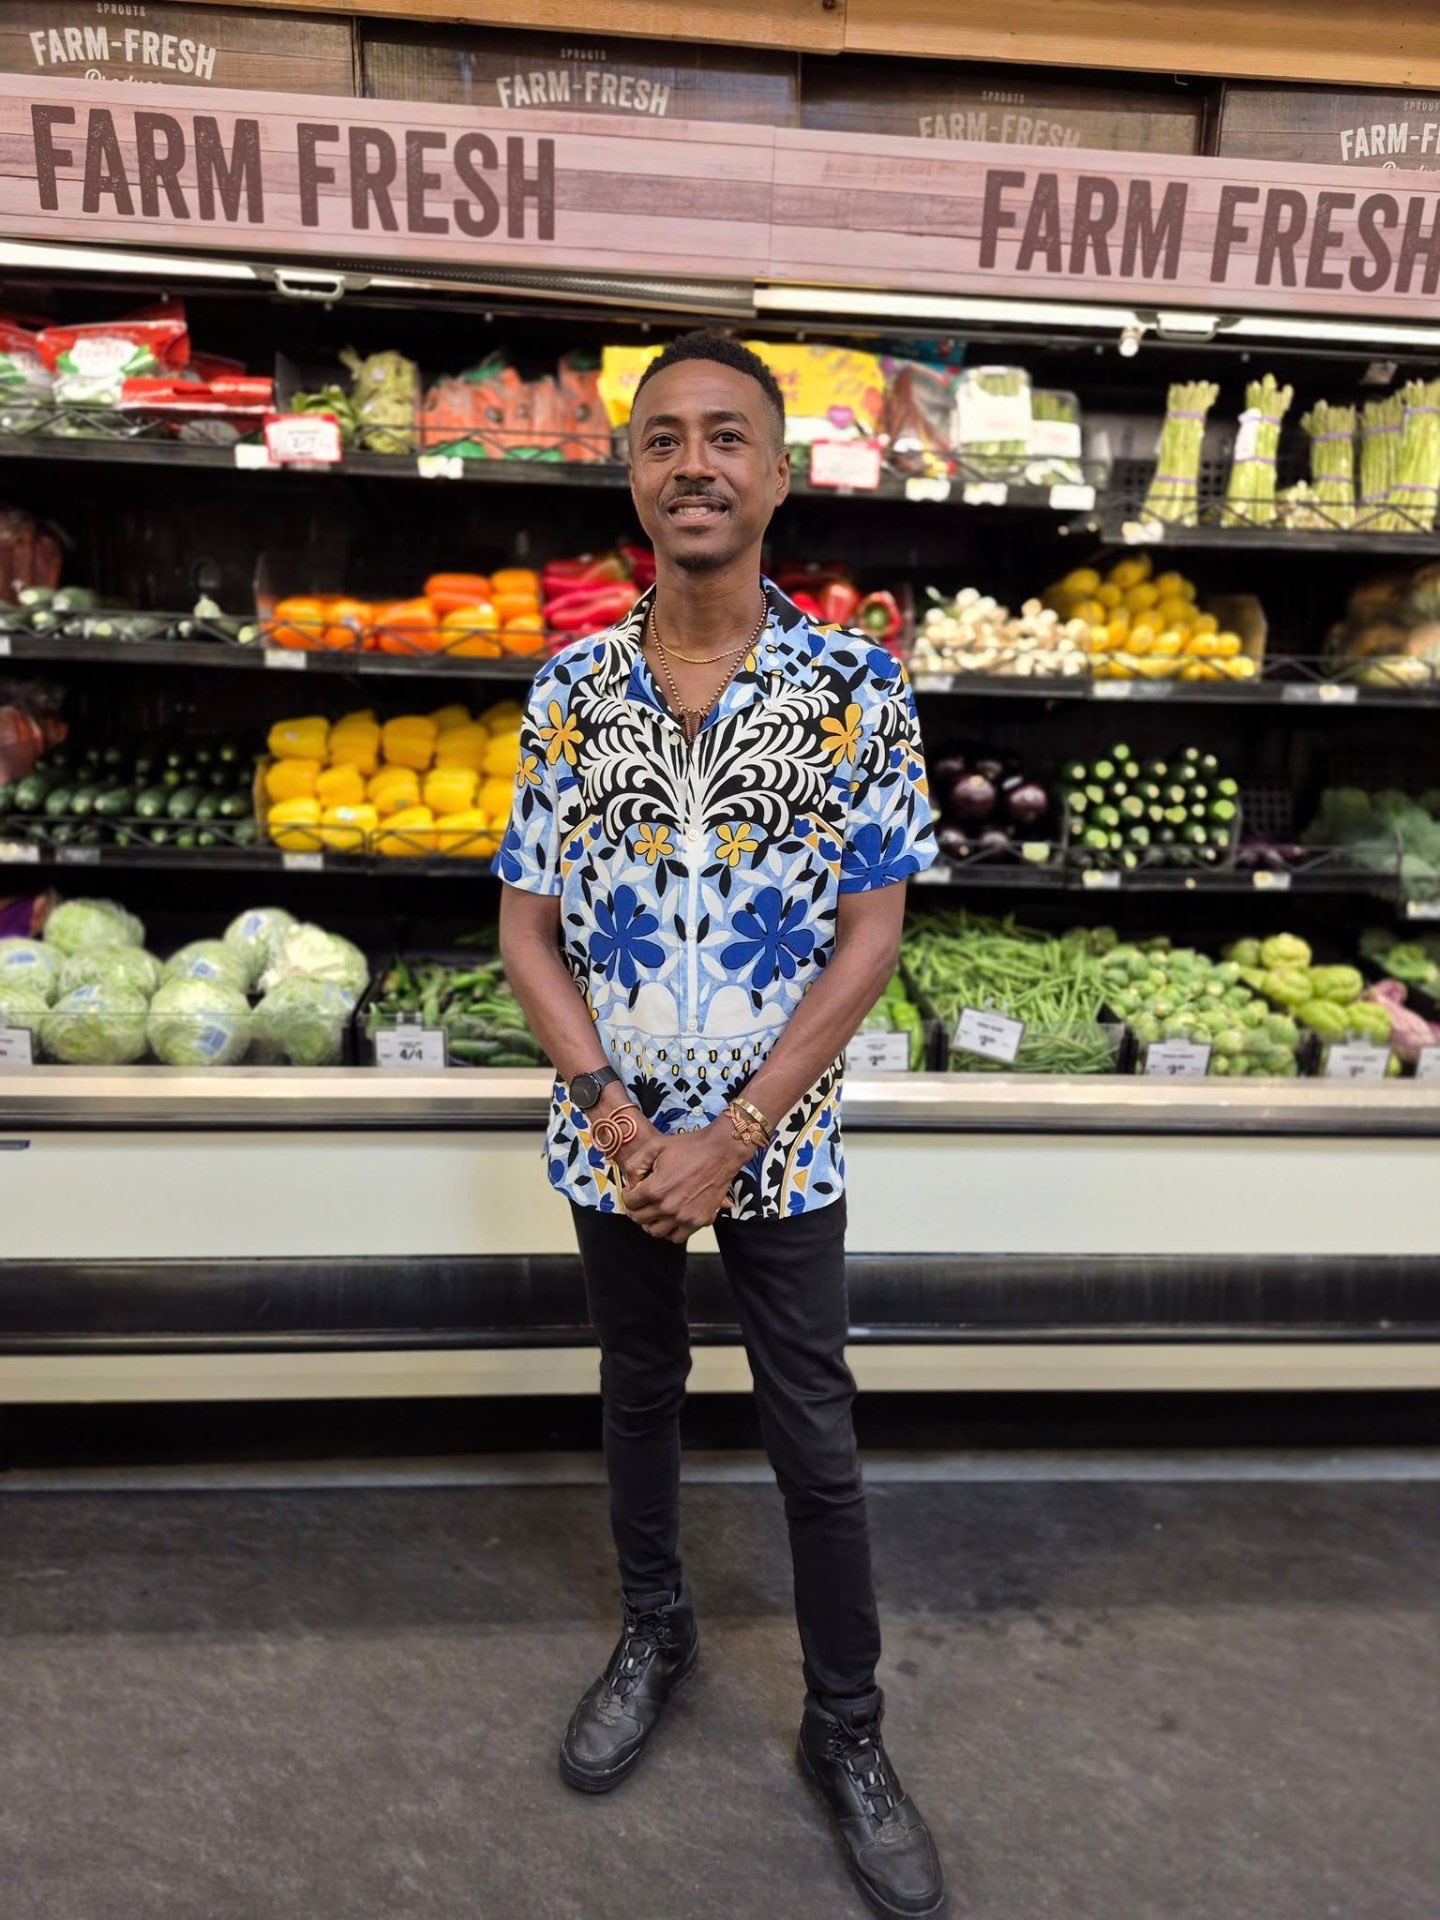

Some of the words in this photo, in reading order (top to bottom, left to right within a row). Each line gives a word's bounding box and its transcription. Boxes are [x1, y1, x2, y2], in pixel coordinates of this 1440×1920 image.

[97, 3, 146, 17] SPROUTS
[29, 26, 217, 80] FARM-FRESH
[560, 48, 607, 61] SPROUTS
[496, 70, 671, 116] FARM-FRESH
[31, 104, 264, 224] FARM
[297, 122, 555, 241] FRESH
[978, 169, 1189, 281] FARM
[1210, 185, 1440, 295] FRESH
